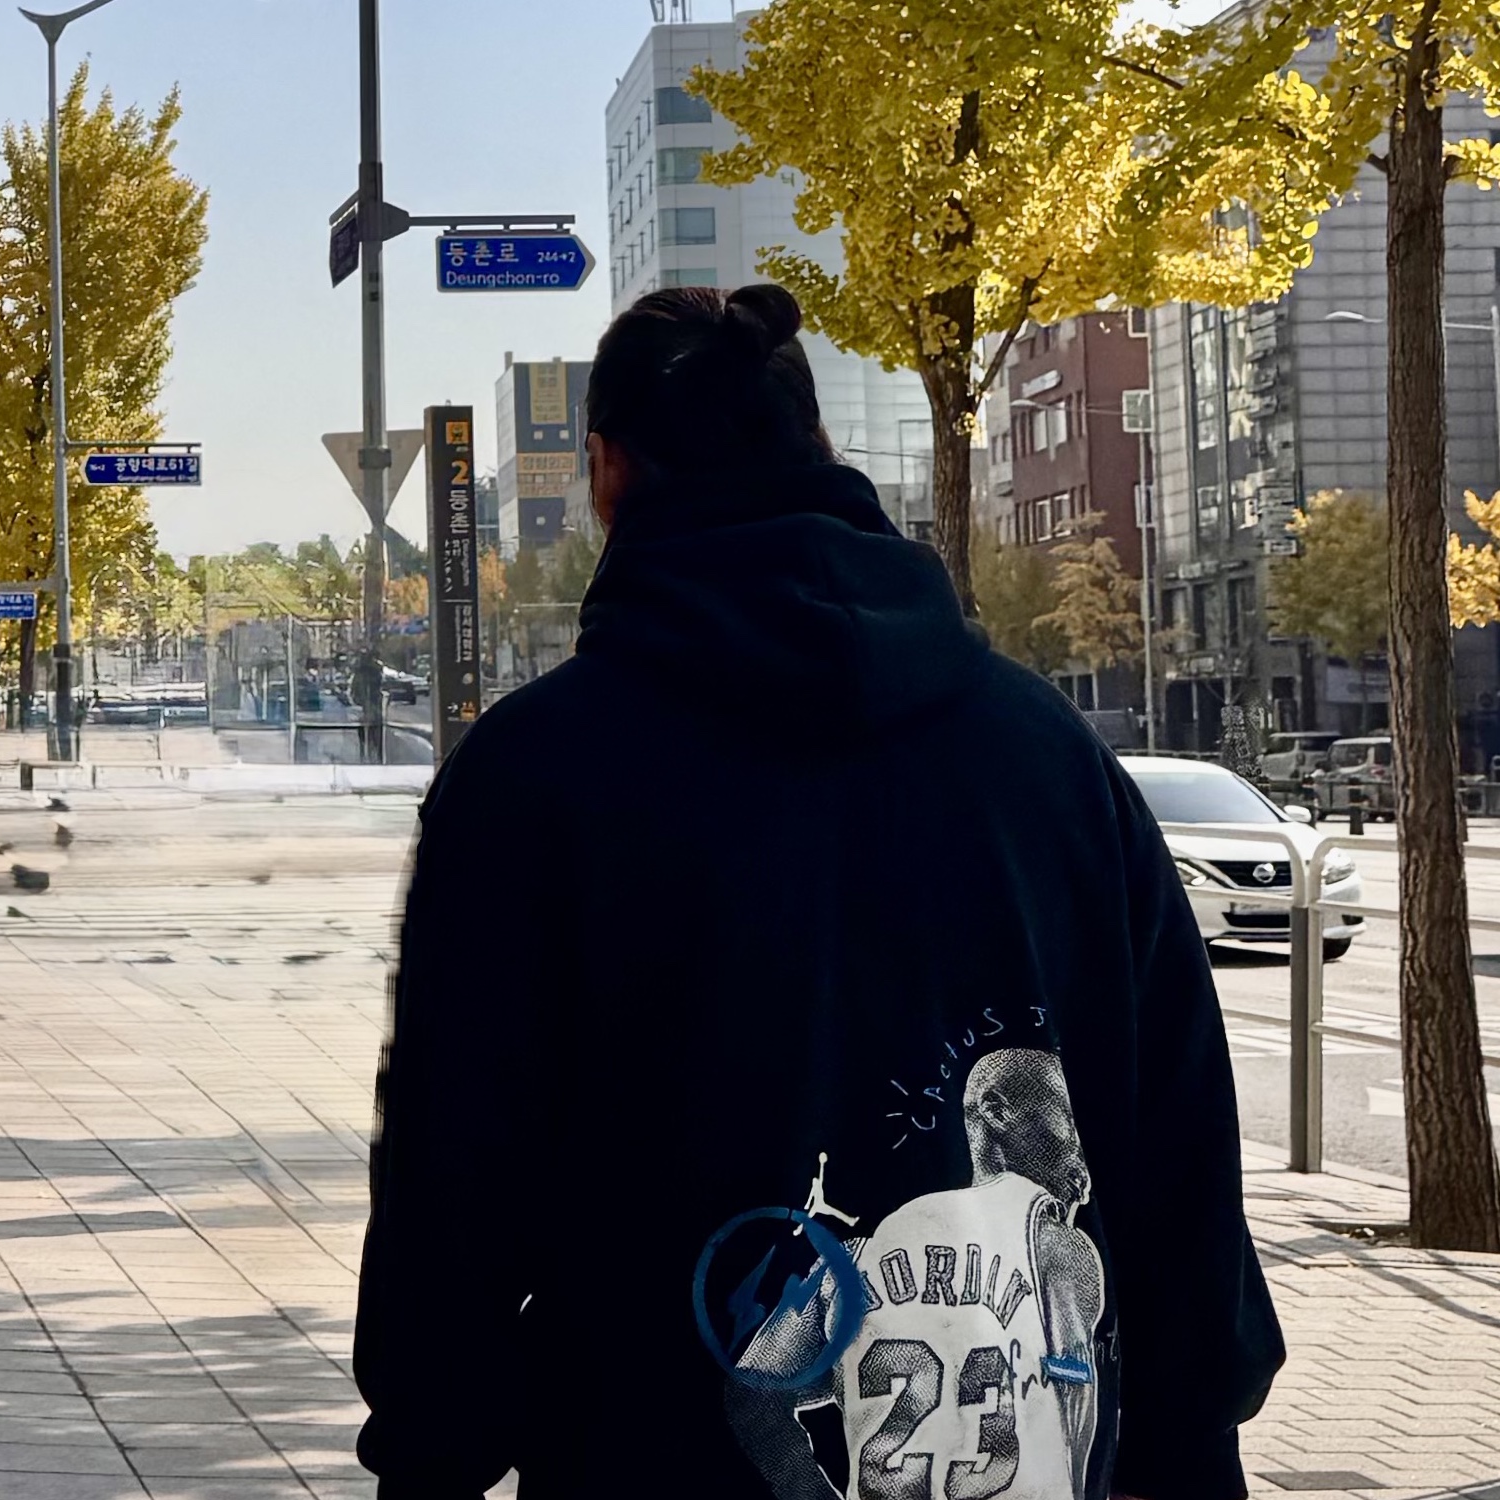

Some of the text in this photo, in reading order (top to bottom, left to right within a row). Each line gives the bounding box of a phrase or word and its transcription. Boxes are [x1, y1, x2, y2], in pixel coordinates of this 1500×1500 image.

[446, 242, 519, 266] 등촌로
[446, 271, 560, 288] Deungchon-ro
[451, 460, 469, 485] 2
[449, 489, 470, 534] 등촌
